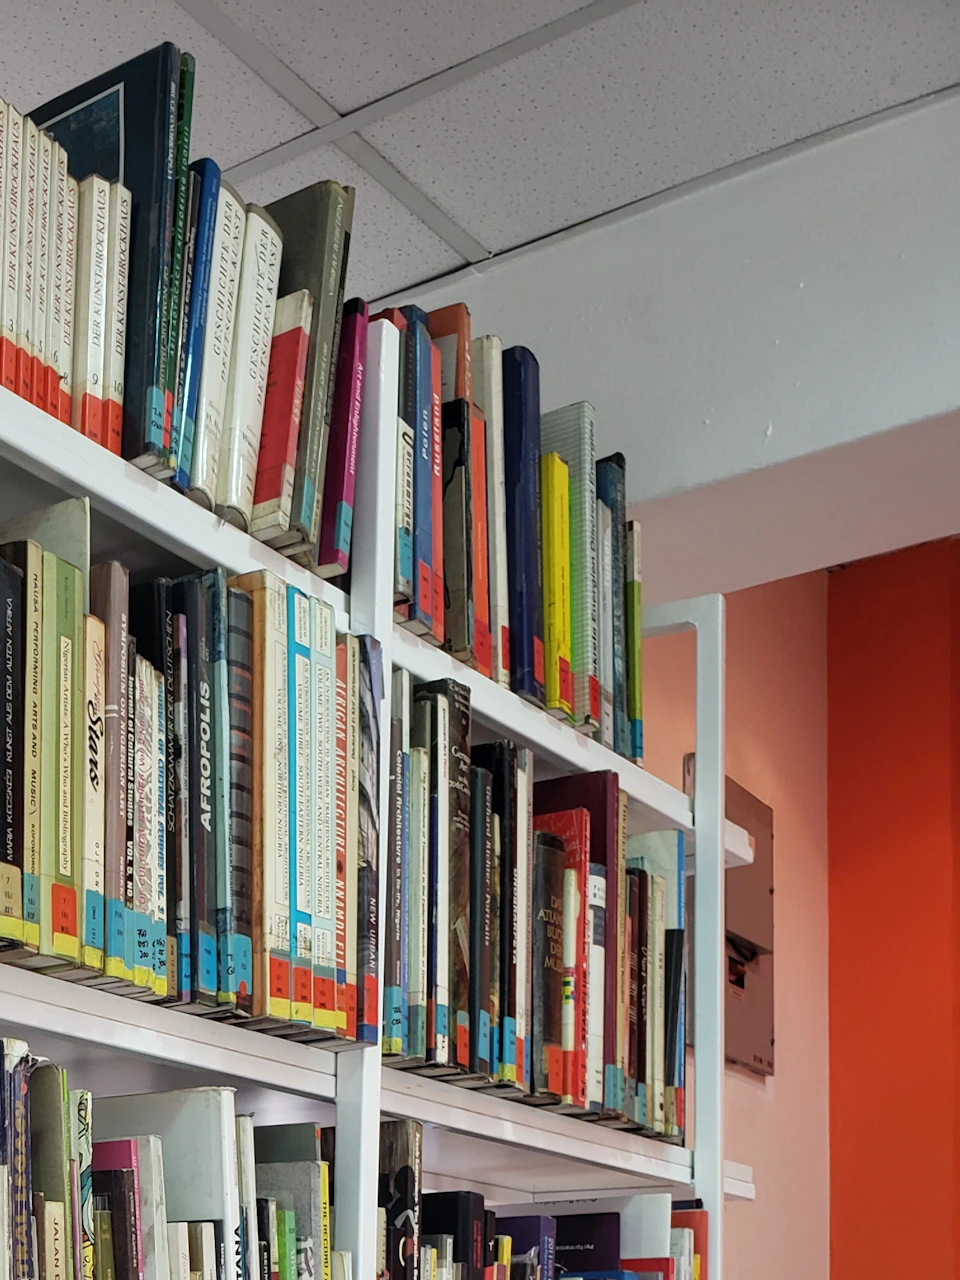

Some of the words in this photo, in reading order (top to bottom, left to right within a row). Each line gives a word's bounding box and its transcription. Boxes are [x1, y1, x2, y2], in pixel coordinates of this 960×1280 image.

[25, 131, 36, 265] KUNST-BROCKHAUS
[213, 242, 230, 355] GESCHICHTE
[223, 201, 233, 236] DER
[249, 269, 265, 380] GESCHICHTE
[260, 228, 269, 263] DER
[293, 377, 304, 424] KUNST
[349, 400, 360, 476] Enlightenment
[432, 393, 441, 476] Russland
[87, 700, 103, 793] Stars
[199, 680, 211, 832] AFROPOLIS
[336, 678, 346, 746] AFRICAN
[336, 749, 346, 855] ARCHITECTURE
[336, 881, 345, 936] NNAMDI
